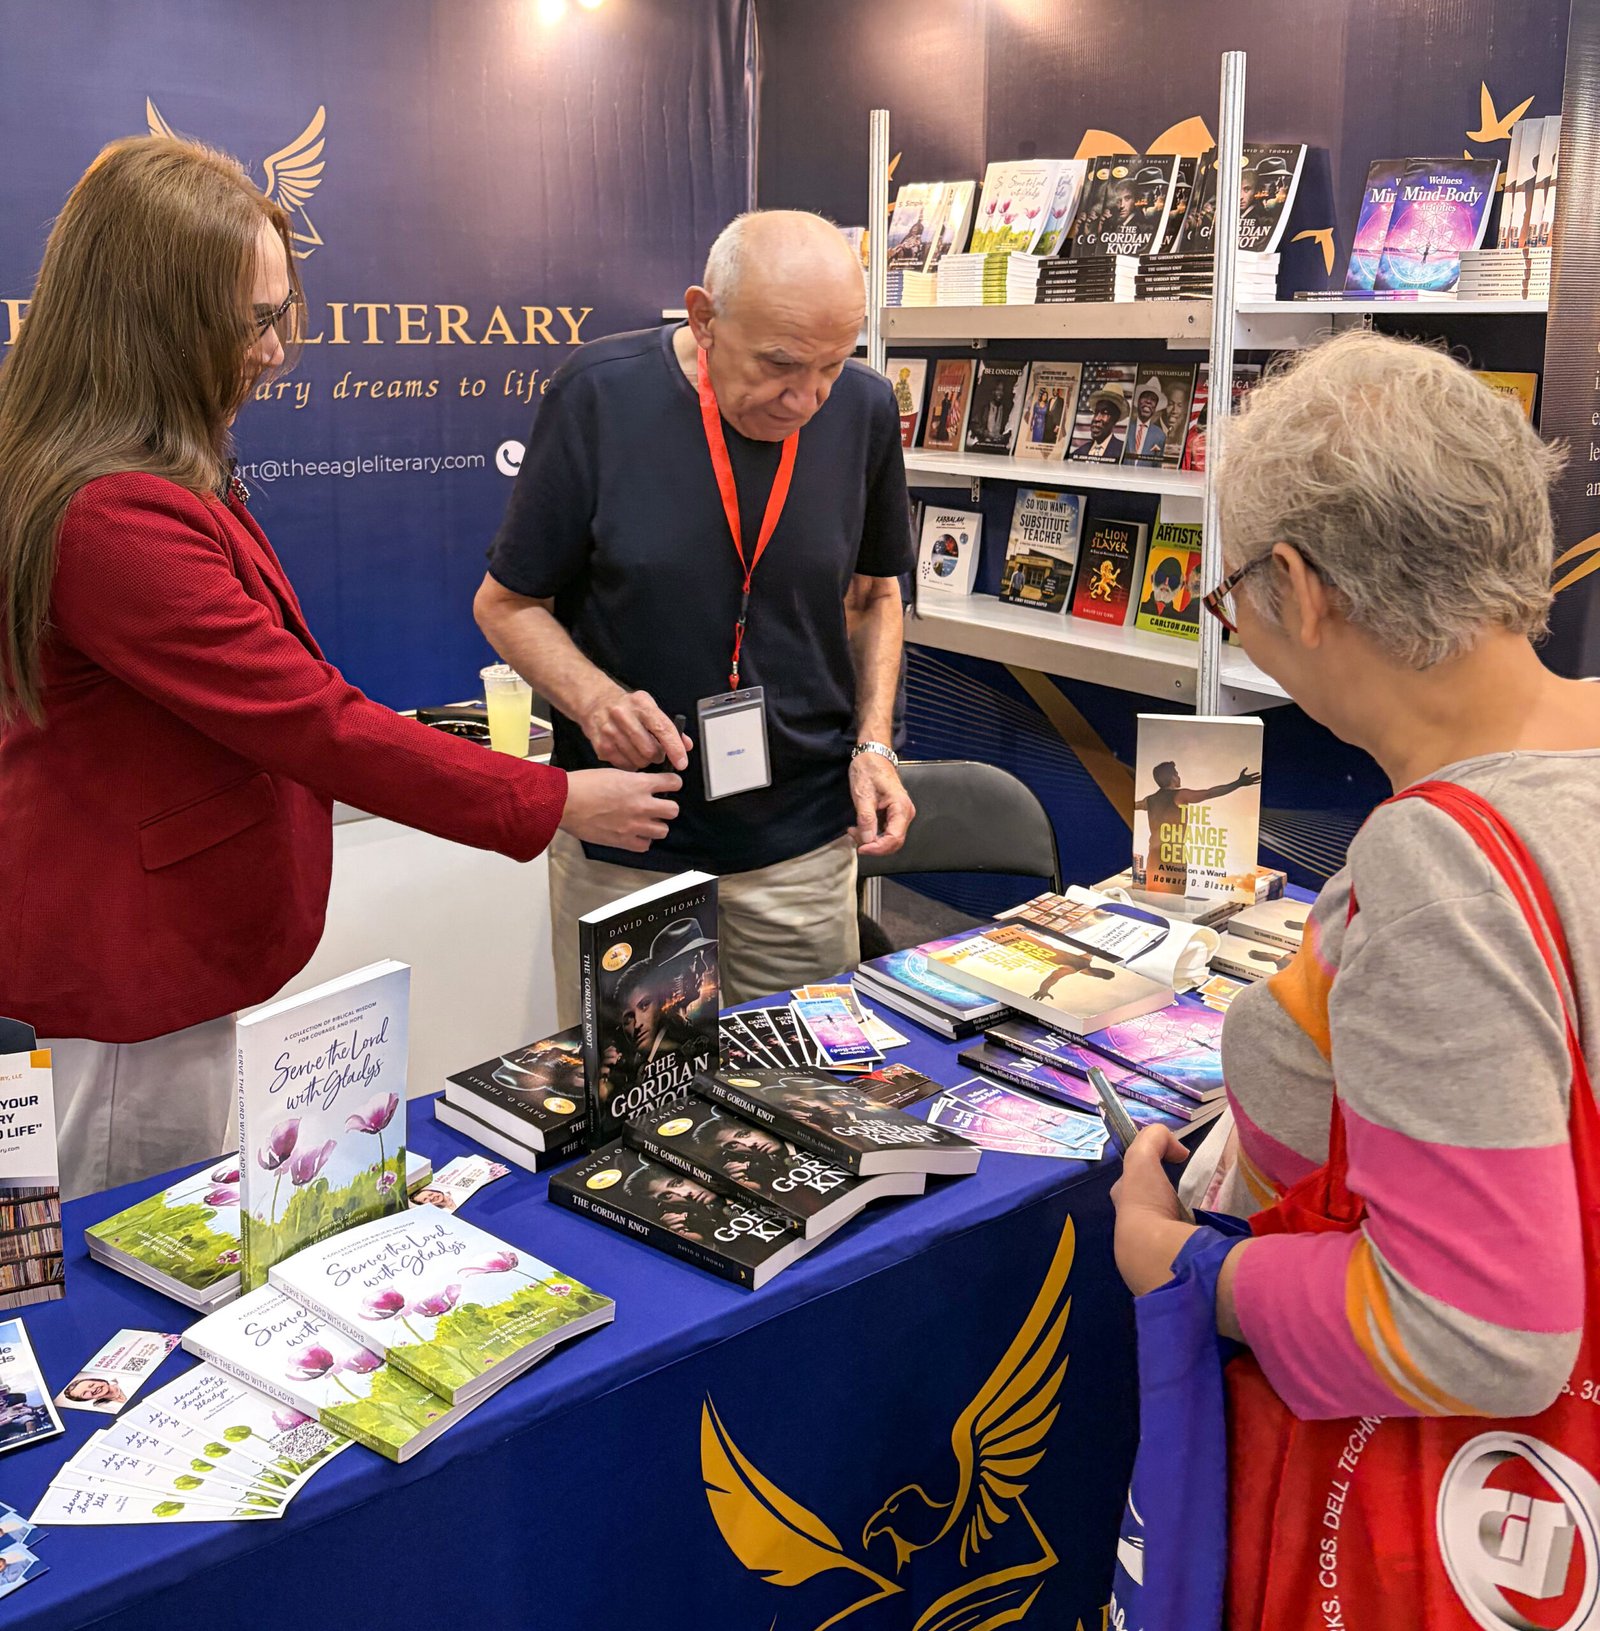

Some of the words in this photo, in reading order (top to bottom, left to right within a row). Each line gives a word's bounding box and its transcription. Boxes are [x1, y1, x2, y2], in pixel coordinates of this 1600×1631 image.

[1429, 176, 1463, 185] Wellness
[1403, 186, 1483, 206] Mind-Body
[1420, 203, 1457, 212] Activities
[1239, 218, 1256, 226] THE
[1100, 232, 1152, 244] GORDIAN
[1106, 242, 1142, 255] KNOT
[286, 302, 593, 346] LITERARY
[984, 367, 1022, 376] BELONGING
[256, 379, 311, 409] ary
[333, 371, 440, 400] dreams
[460, 376, 486, 397] to
[503, 369, 550, 404] life
[233, 455, 485, 482] ort@theeagleliterary.com
[1026, 499, 1034, 509] SO
[1036, 500, 1048, 511] YOU
[1050, 502, 1067, 514] WANT
[1020, 514, 1069, 533] SUBSTITUTE
[1105, 528, 1128, 541] LION
[1156, 524, 1203, 546] ARTIST'S
[1023, 528, 1062, 545] TEACHER
[1091, 537, 1129, 554] SLAYER
[1150, 618, 1180, 630] CARLTON
[1181, 623, 1200, 634] DAVIS
[1178, 804, 1211, 825] THE
[1160, 823, 1228, 848] CHANGE
[1160, 843, 1226, 868] CENTER
[1153, 874, 1186, 885] Howard
[1191, 878, 1200, 887] D.
[1204, 880, 1235, 892] Blazek
[1165, 865, 1186, 873] Week
[1206, 869, 1227, 878] Ward
[610, 920, 642, 938] DAVID
[648, 914, 658, 922] O.
[664, 895, 706, 917] THOMAS
[584, 977, 593, 1020] GORDIAN
[289, 1023, 322, 1040] COLLECTION
[332, 1010, 354, 1022] BIBLICAL
[356, 1001, 377, 1013] WISDOM
[298, 1035, 309, 1044] FOR
[310, 1026, 335, 1039] COURAGE
[337, 1021, 348, 1029] AND
[349, 1014, 364, 1023] HOPE
[585, 1023, 593, 1048] KNOT
[269, 1052, 327, 1094] Serve
[325, 1039, 350, 1069] the
[351, 1016, 389, 1060] Lord
[644, 1052, 676, 1078] THE
[1023, 1047, 1043, 1062] Mind-Body
[287, 1076, 324, 1110] with
[322, 1053, 384, 1111] Gladys
[468, 1076, 502, 1096] THOMAS
[611, 1052, 710, 1118] GORDIAN
[980, 1063, 999, 1075] Wellness
[998, 1069, 1020, 1084] Mind-Body
[1020, 1079, 1040, 1090] Activities
[0, 1095, 38, 1110] YOUR
[518, 1102, 547, 1119] DAVID
[650, 1105, 685, 1124] DAVID
[712, 1084, 726, 1098] THE
[727, 1093, 756, 1115] GORDIAN
[757, 1108, 776, 1123] KNOT
[8, 1123, 42, 1138] LIFE"
[832, 1124, 939, 1137] GORDIAN
[853, 1119, 890, 1127] THE
[561, 1141, 579, 1155] THE
[863, 1130, 941, 1145] KNOT
[577, 1154, 611, 1177] DAVID
[644, 1140, 659, 1155] THE
[660, 1149, 691, 1172] GORDIAN
[693, 1167, 712, 1183] KNOT
[572, 1195, 589, 1209] THE
[591, 1203, 626, 1226] GORDIAN
[628, 1220, 650, 1236] KNOT
[326, 1253, 388, 1287] Serve
[383, 1242, 411, 1258] the
[406, 1224, 453, 1248] Lord
[363, 1262, 402, 1288] with
[401, 1241, 466, 1276] Gladys
[244, 1305, 308, 1346] Serve
[283, 1284, 300, 1303] SERVE
[300, 1295, 310, 1306] THE
[312, 1304, 326, 1317] LORD
[328, 1312, 342, 1327] WITH
[342, 1322, 365, 1342] GLADYS
[286, 1317, 326, 1347] with
[199, 1349, 218, 1364] SERVE
[219, 1359, 231, 1371] THE
[232, 1366, 250, 1380] LORD
[251, 1376, 268, 1390] WITH
[269, 1386, 295, 1405] GLADYS
[174, 1386, 201, 1406] Serve
[200, 1376, 216, 1386] the
[182, 1392, 205, 1410] Lord
[205, 1378, 227, 1393] with
[194, 1388, 229, 1410] Gladys
[1338, 1414, 1387, 1474] TECHN
[1322, 1479, 1350, 1531] DELL
[1318, 1535, 1338, 1589] CGS.
[1322, 1595, 1345, 1631] KS.
